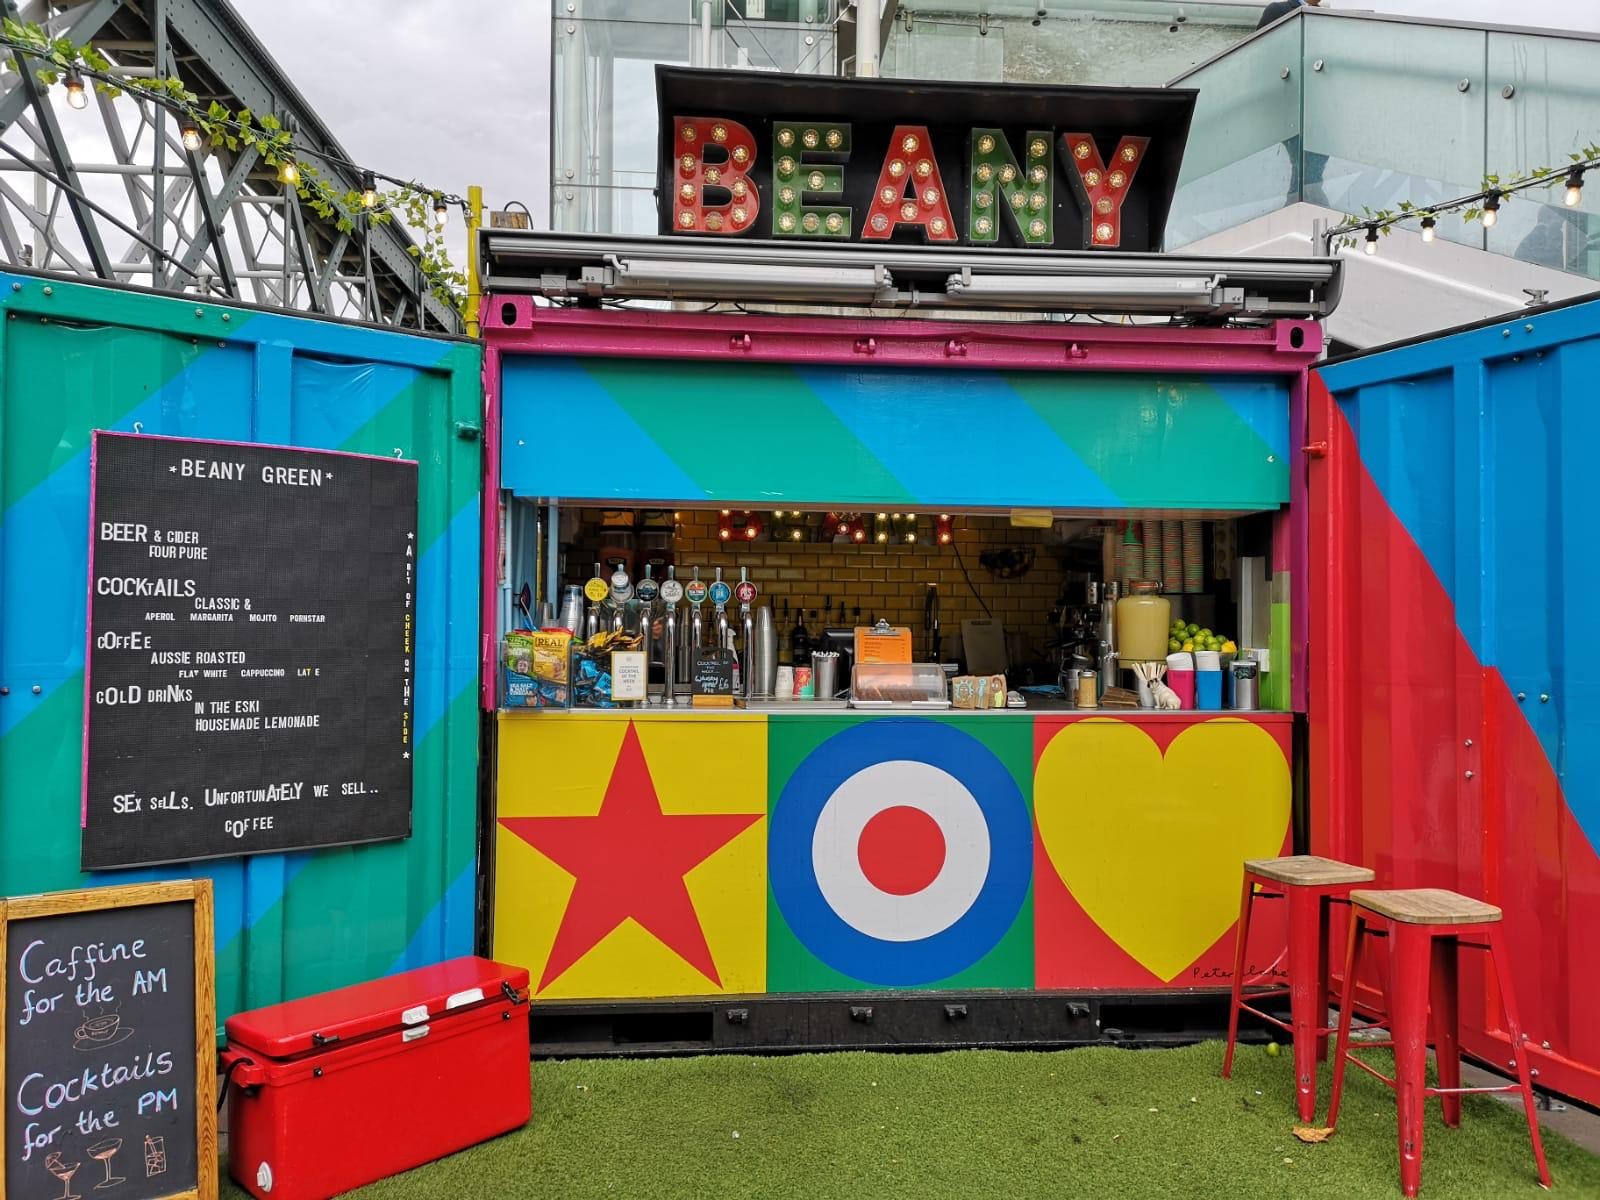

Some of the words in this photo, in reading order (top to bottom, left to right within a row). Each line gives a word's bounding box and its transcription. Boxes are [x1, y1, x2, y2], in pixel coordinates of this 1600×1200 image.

[673, 116, 1151, 248] BEANY
[181, 458, 246, 481] BEANY
[262, 466, 322, 487] GREEN
[101, 522, 148, 543] BEER
[154, 530, 161, 543] &
[167, 531, 199, 544] CIDER
[149, 545, 176, 559] FOUR
[179, 547, 208, 560] PURE
[194, 597, 240, 610] CLASSIC
[244, 598, 252, 611] &
[145, 612, 176, 621] APEROL
[190, 613, 234, 622] MARGARITA
[249, 614, 277, 622] MOJITO
[289, 614, 326, 623] PORNSTAR
[536, 637, 564, 648] REAL
[150, 651, 191, 665] AUSSIE
[196, 652, 246, 665] ROASTED
[178, 670, 199, 678] FLAT
[203, 669, 228, 678] WHITE
[240, 668, 285, 678] CAPPUCCINO
[195, 702, 204, 715] IN
[209, 701, 231, 714] THE
[235, 700, 260, 713] ESKI
[195, 717, 260, 732] HOUSEMADE
[264, 714, 320, 729] LEMONADE
[313, 784, 329, 798] WE
[19, 939, 147, 984] Caffine
[1193, 967, 1234, 978] Peter
[19, 988, 63, 1026] for
[75, 981, 115, 1007] the
[132, 967, 168, 997] AM
[17, 1051, 173, 1117] Cocktails
[21, 1122, 62, 1161] for
[75, 1109, 120, 1135] the
[137, 1088, 178, 1116] PM
